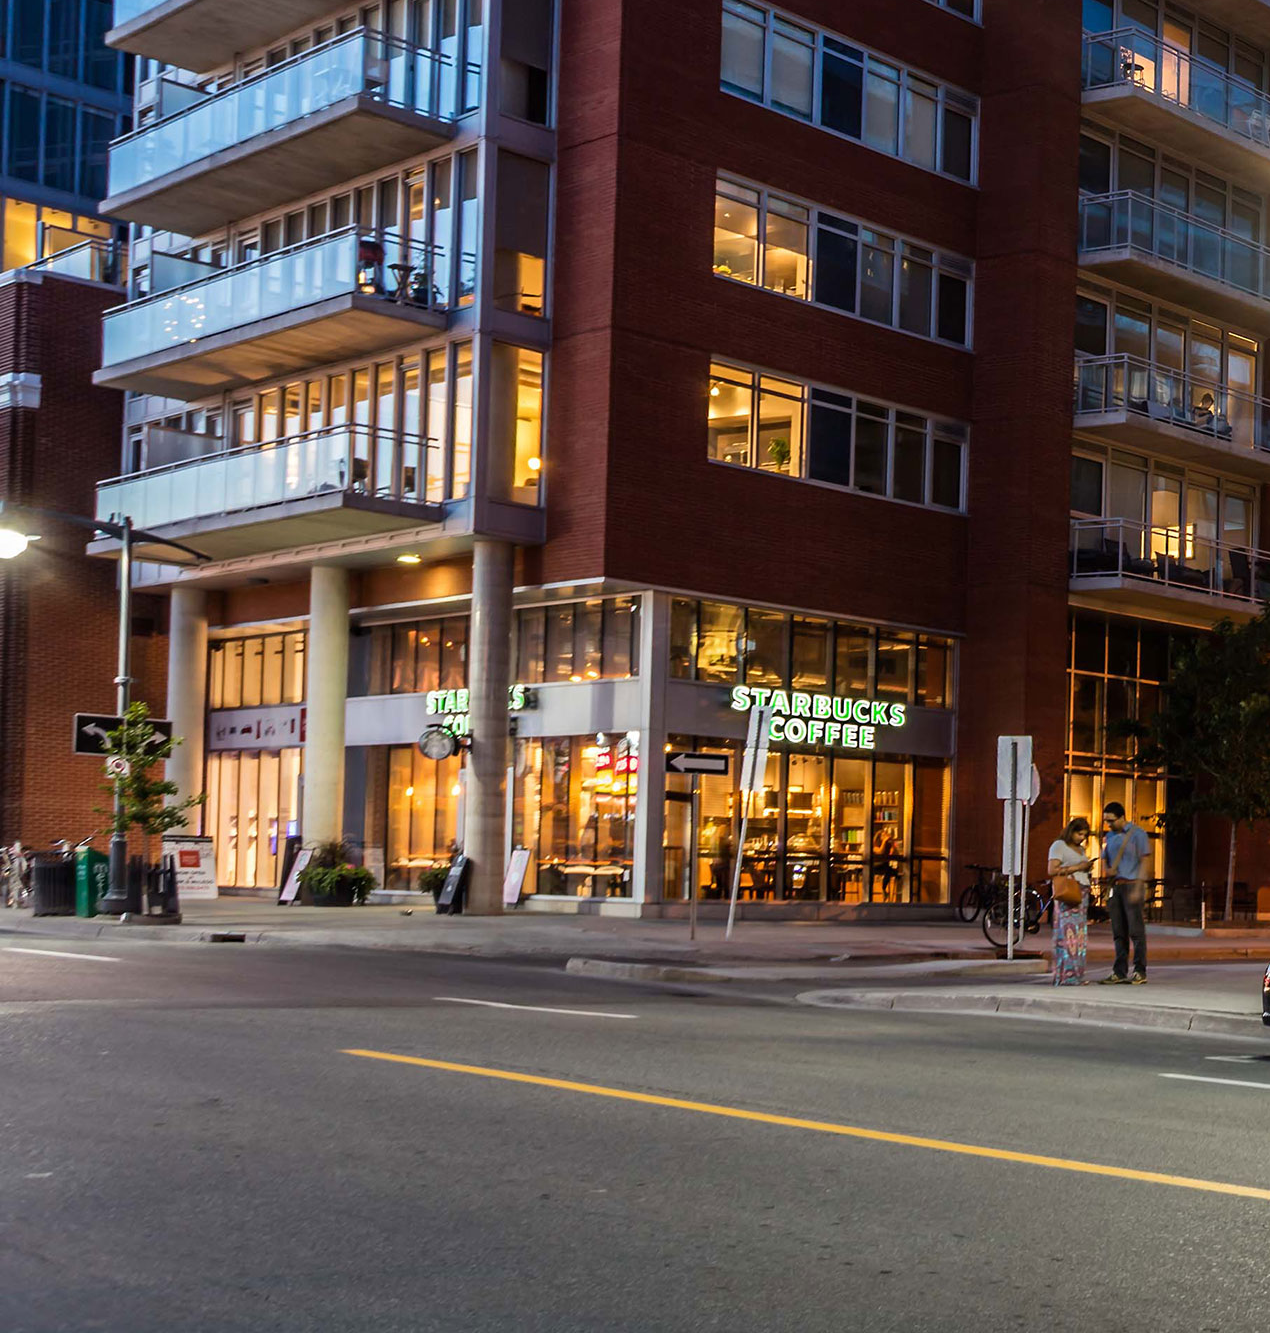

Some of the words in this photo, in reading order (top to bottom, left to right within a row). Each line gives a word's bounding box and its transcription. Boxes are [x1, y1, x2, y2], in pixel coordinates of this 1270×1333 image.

[426, 683, 526, 715] STARS
[731, 685, 906, 727] STARBUCKS
[769, 716, 876, 749] COFFEE
